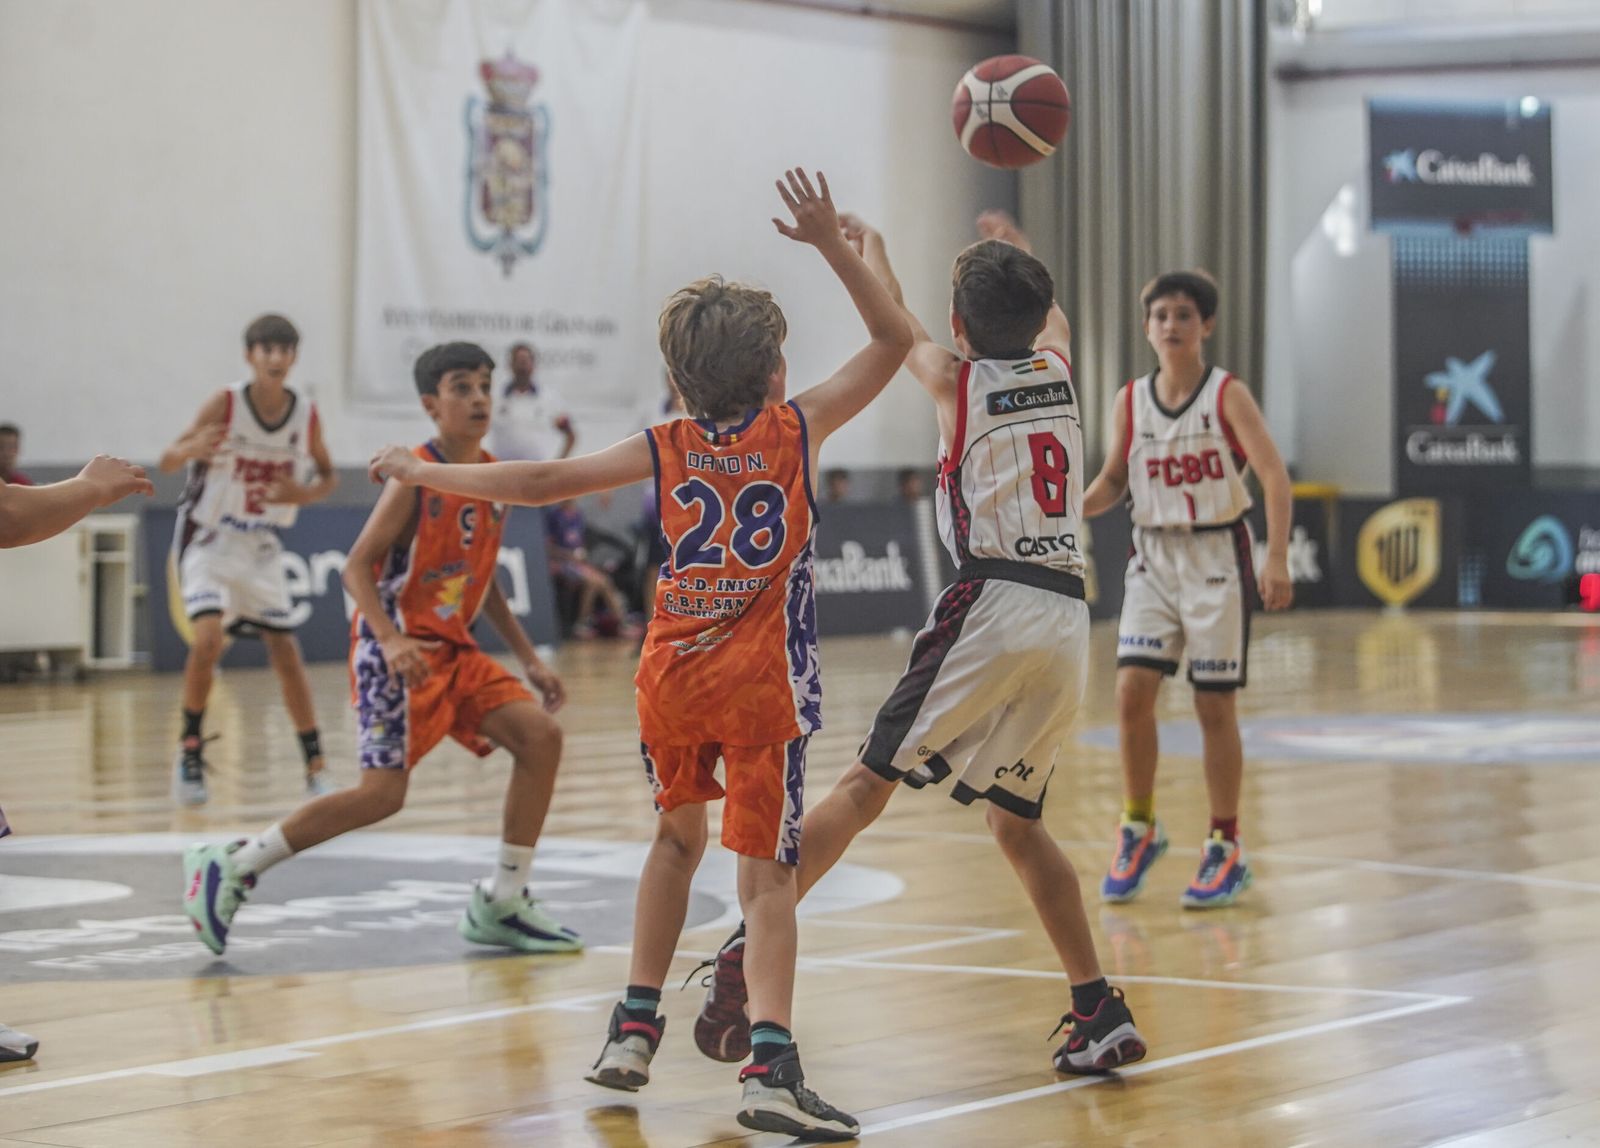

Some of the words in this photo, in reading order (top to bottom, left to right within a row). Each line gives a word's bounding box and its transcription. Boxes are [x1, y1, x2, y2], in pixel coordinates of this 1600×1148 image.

[1013, 386, 1069, 407] CaixaBank
[746, 451, 768, 472] N.
[1027, 432, 1070, 518] 8
[670, 476, 788, 572] 28
